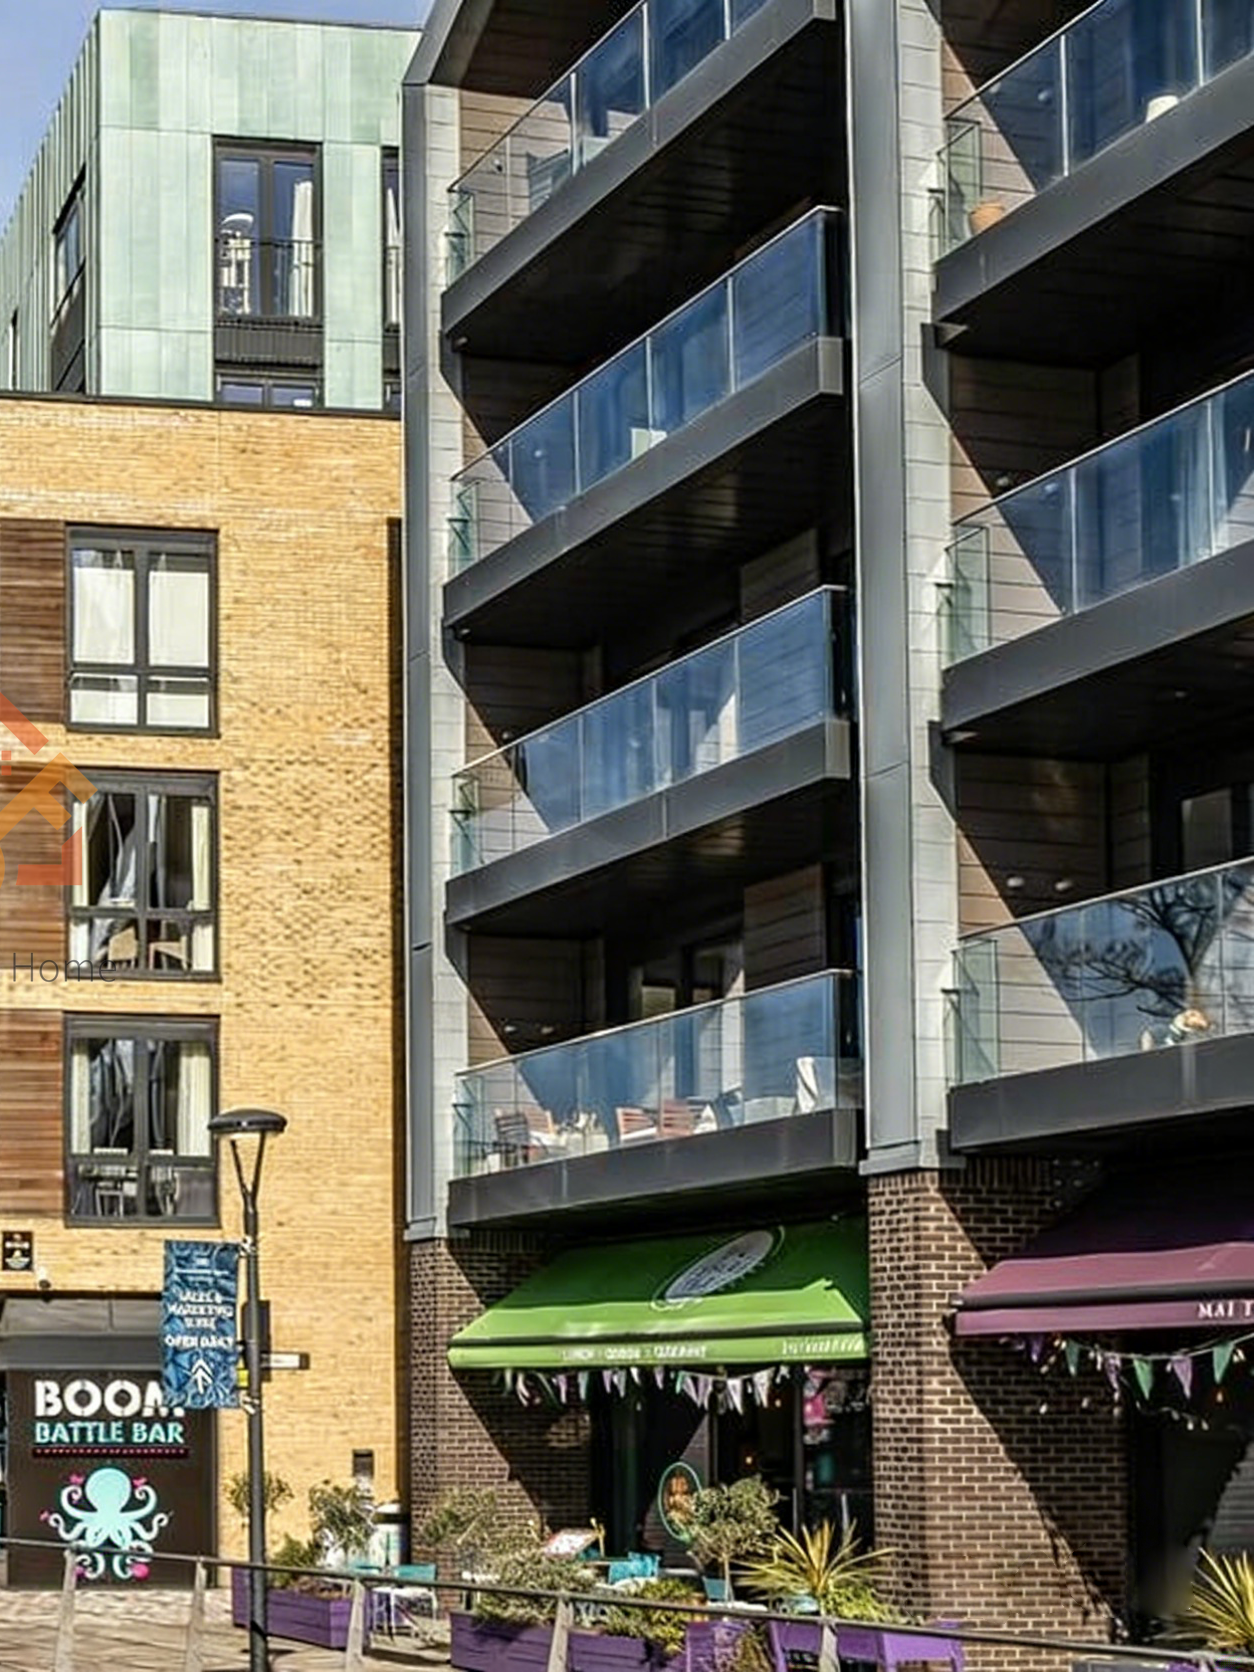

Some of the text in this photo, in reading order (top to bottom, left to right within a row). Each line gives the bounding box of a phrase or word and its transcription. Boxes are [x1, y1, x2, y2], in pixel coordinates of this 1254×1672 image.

[1198, 1300, 1234, 1318] MAI
[34, 1421, 185, 1444] BATTLE BAR
